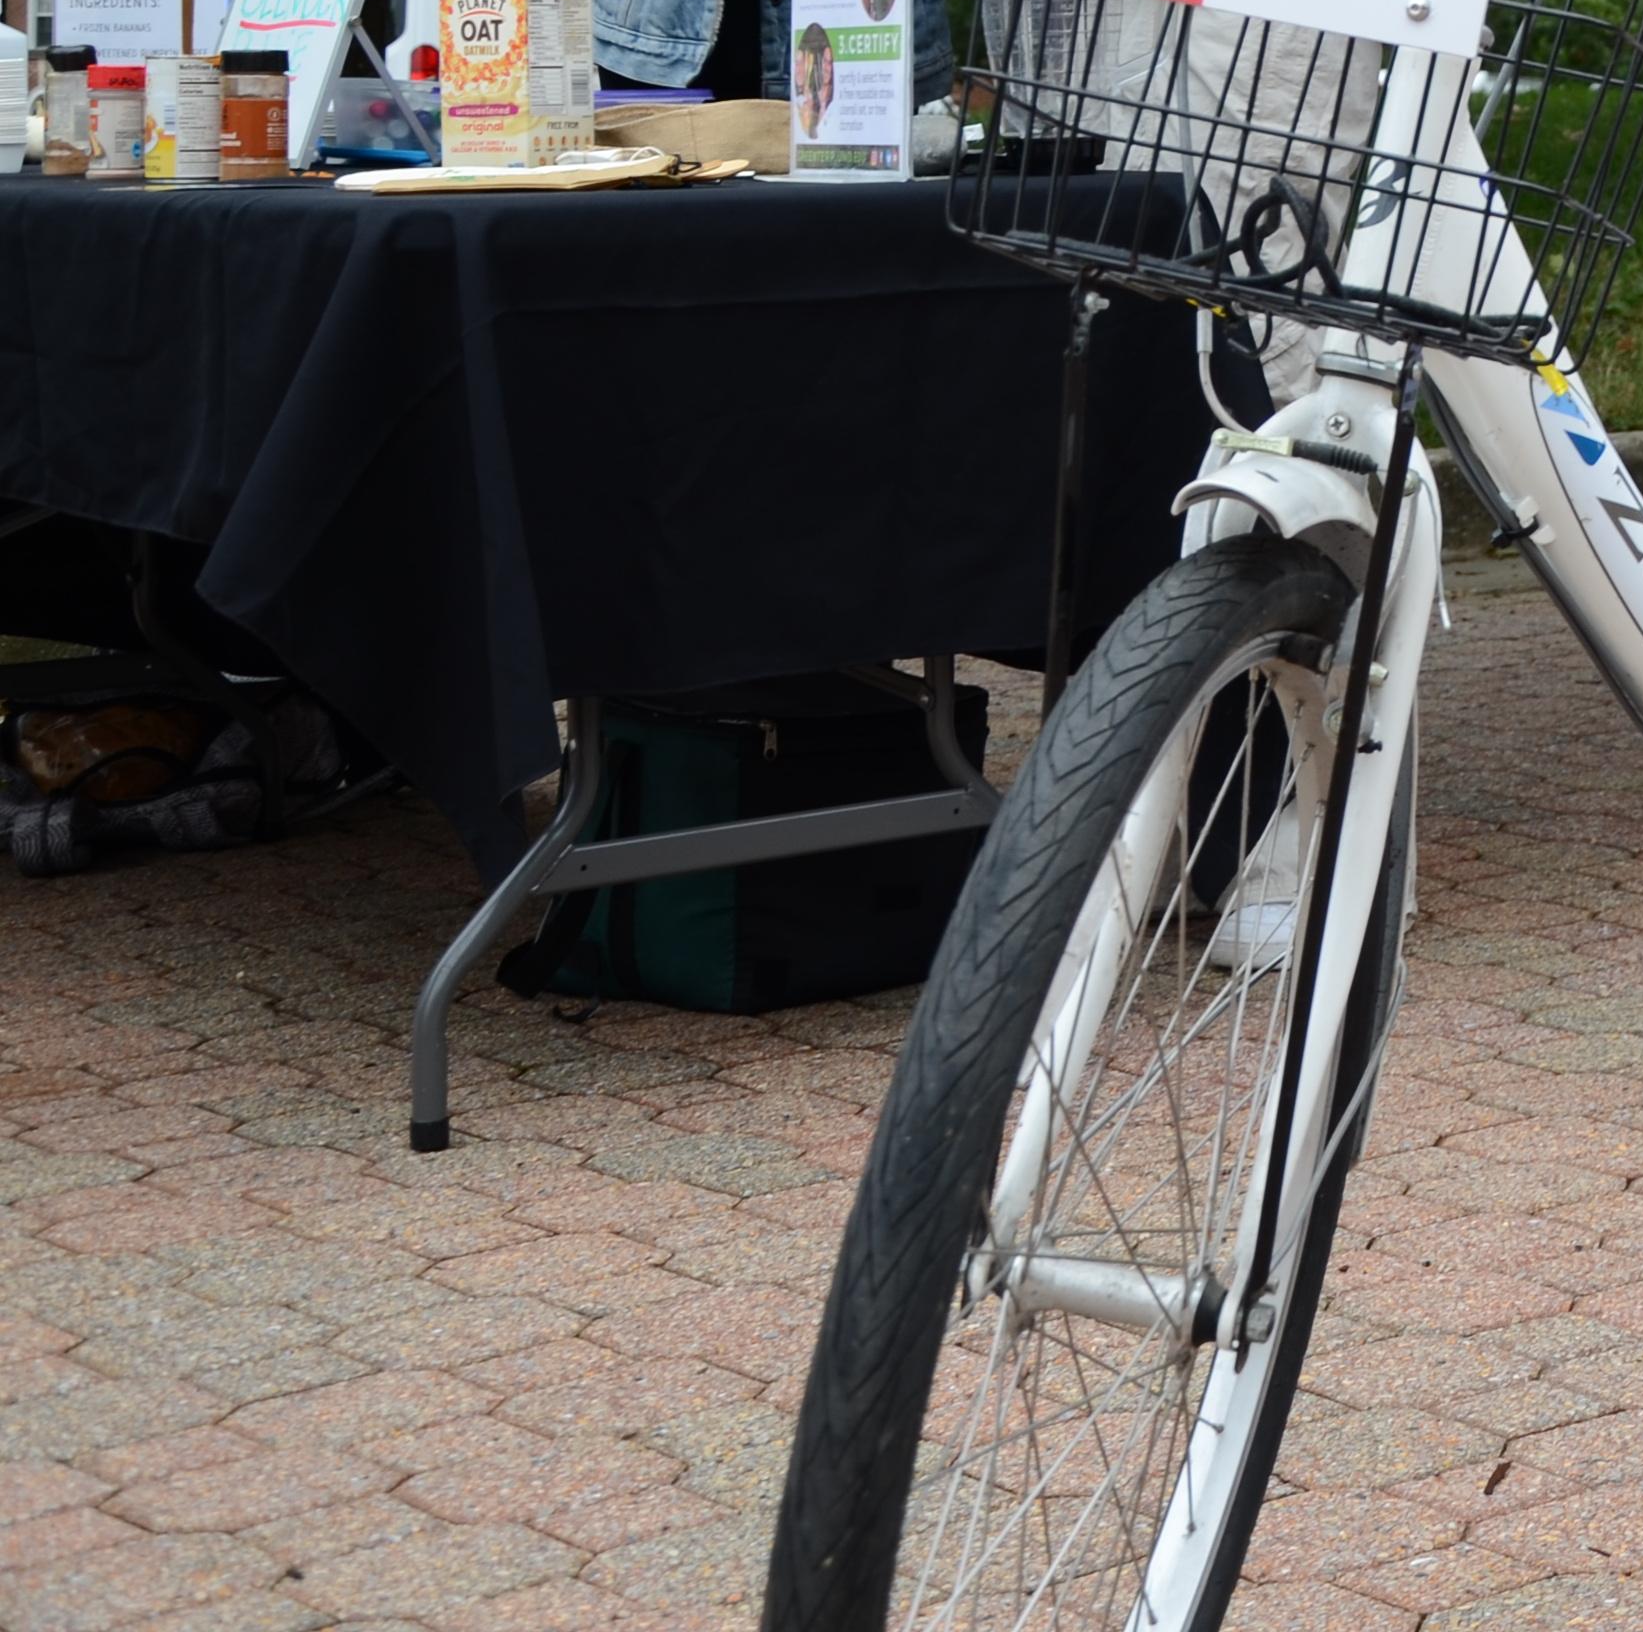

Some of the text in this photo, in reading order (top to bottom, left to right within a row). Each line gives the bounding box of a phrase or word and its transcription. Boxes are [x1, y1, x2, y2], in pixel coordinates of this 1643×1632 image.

[461, 19, 504, 42] OAT
[464, 45, 500, 56] OATMILK
[838, 32, 900, 55] 3.CERTIFY
[455, 105, 511, 116] unsweetened
[462, 121, 504, 136] original
